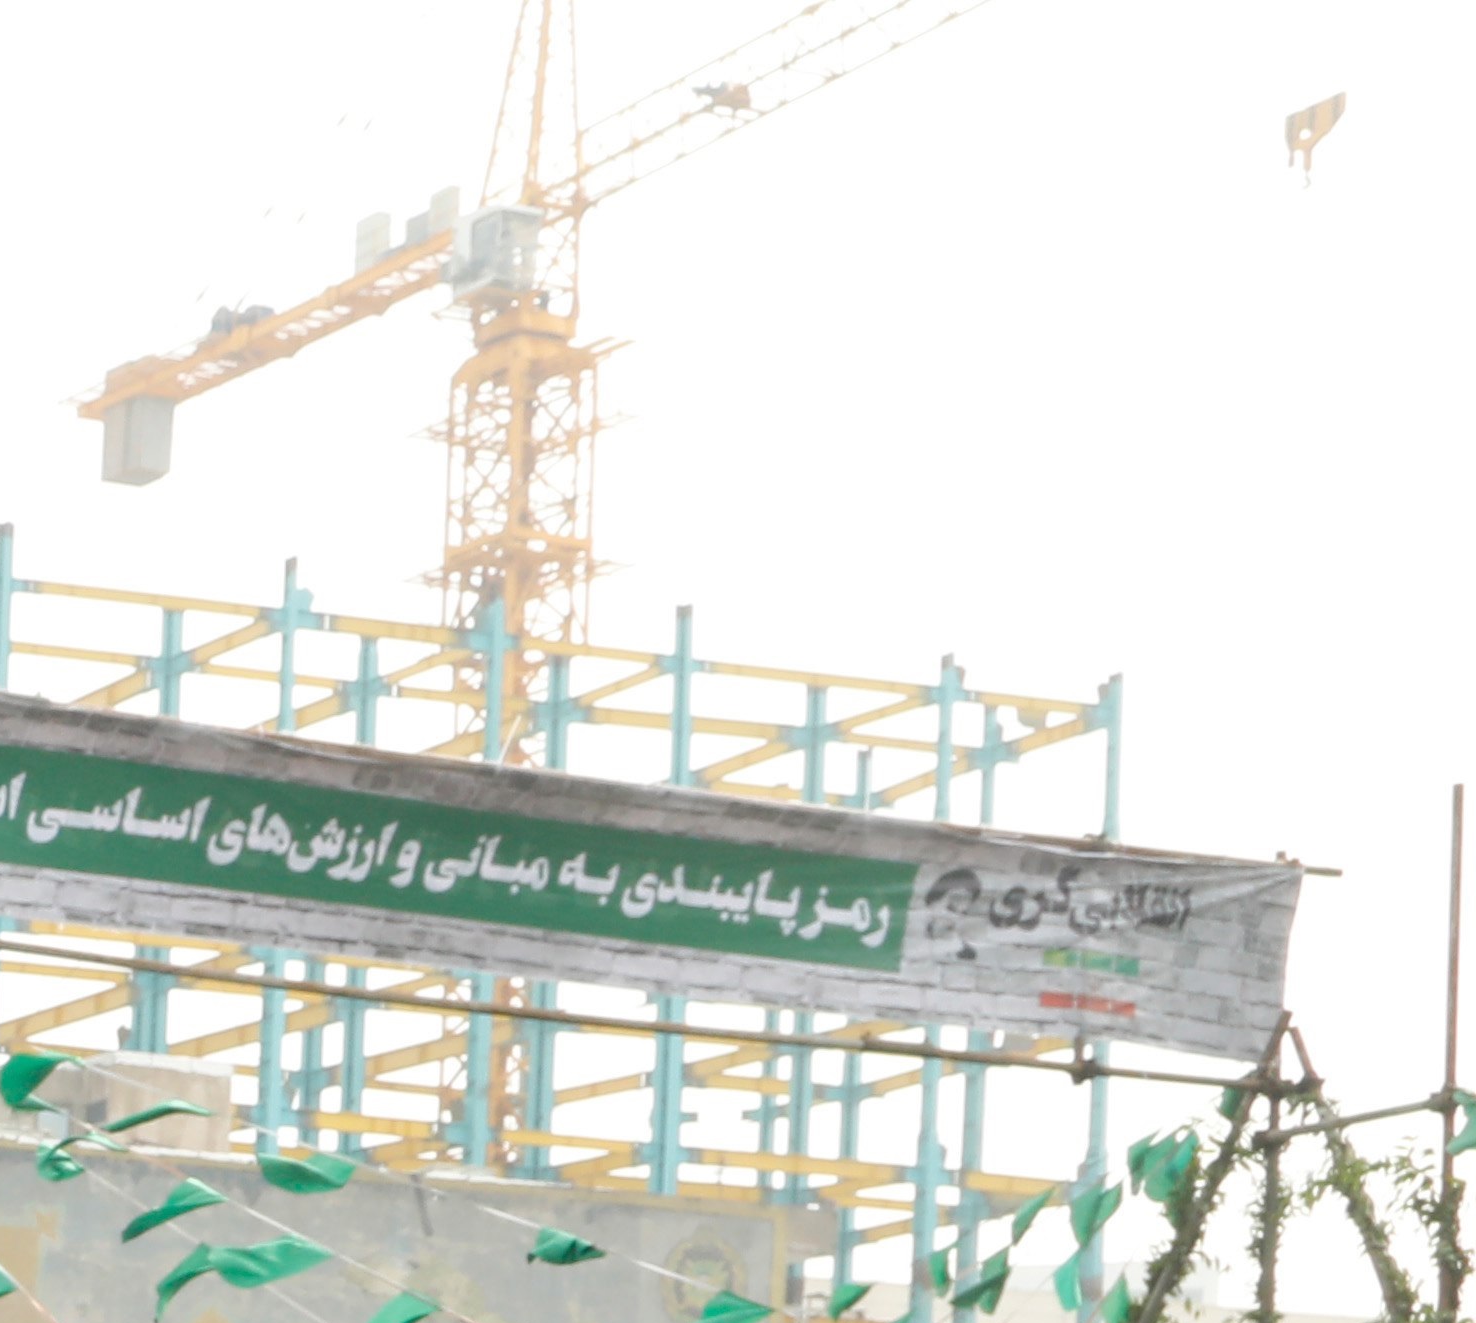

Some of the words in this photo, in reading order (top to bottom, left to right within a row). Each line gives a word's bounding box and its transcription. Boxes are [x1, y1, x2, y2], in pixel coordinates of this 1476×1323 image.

[26, 786, 212, 844] اساسی
[388, 837, 422, 888] و
[422, 834, 550, 895] مبانی
[557, 851, 620, 905] به
[621, 864, 799, 937] پایبندی
[798, 884, 891, 948] رمز
